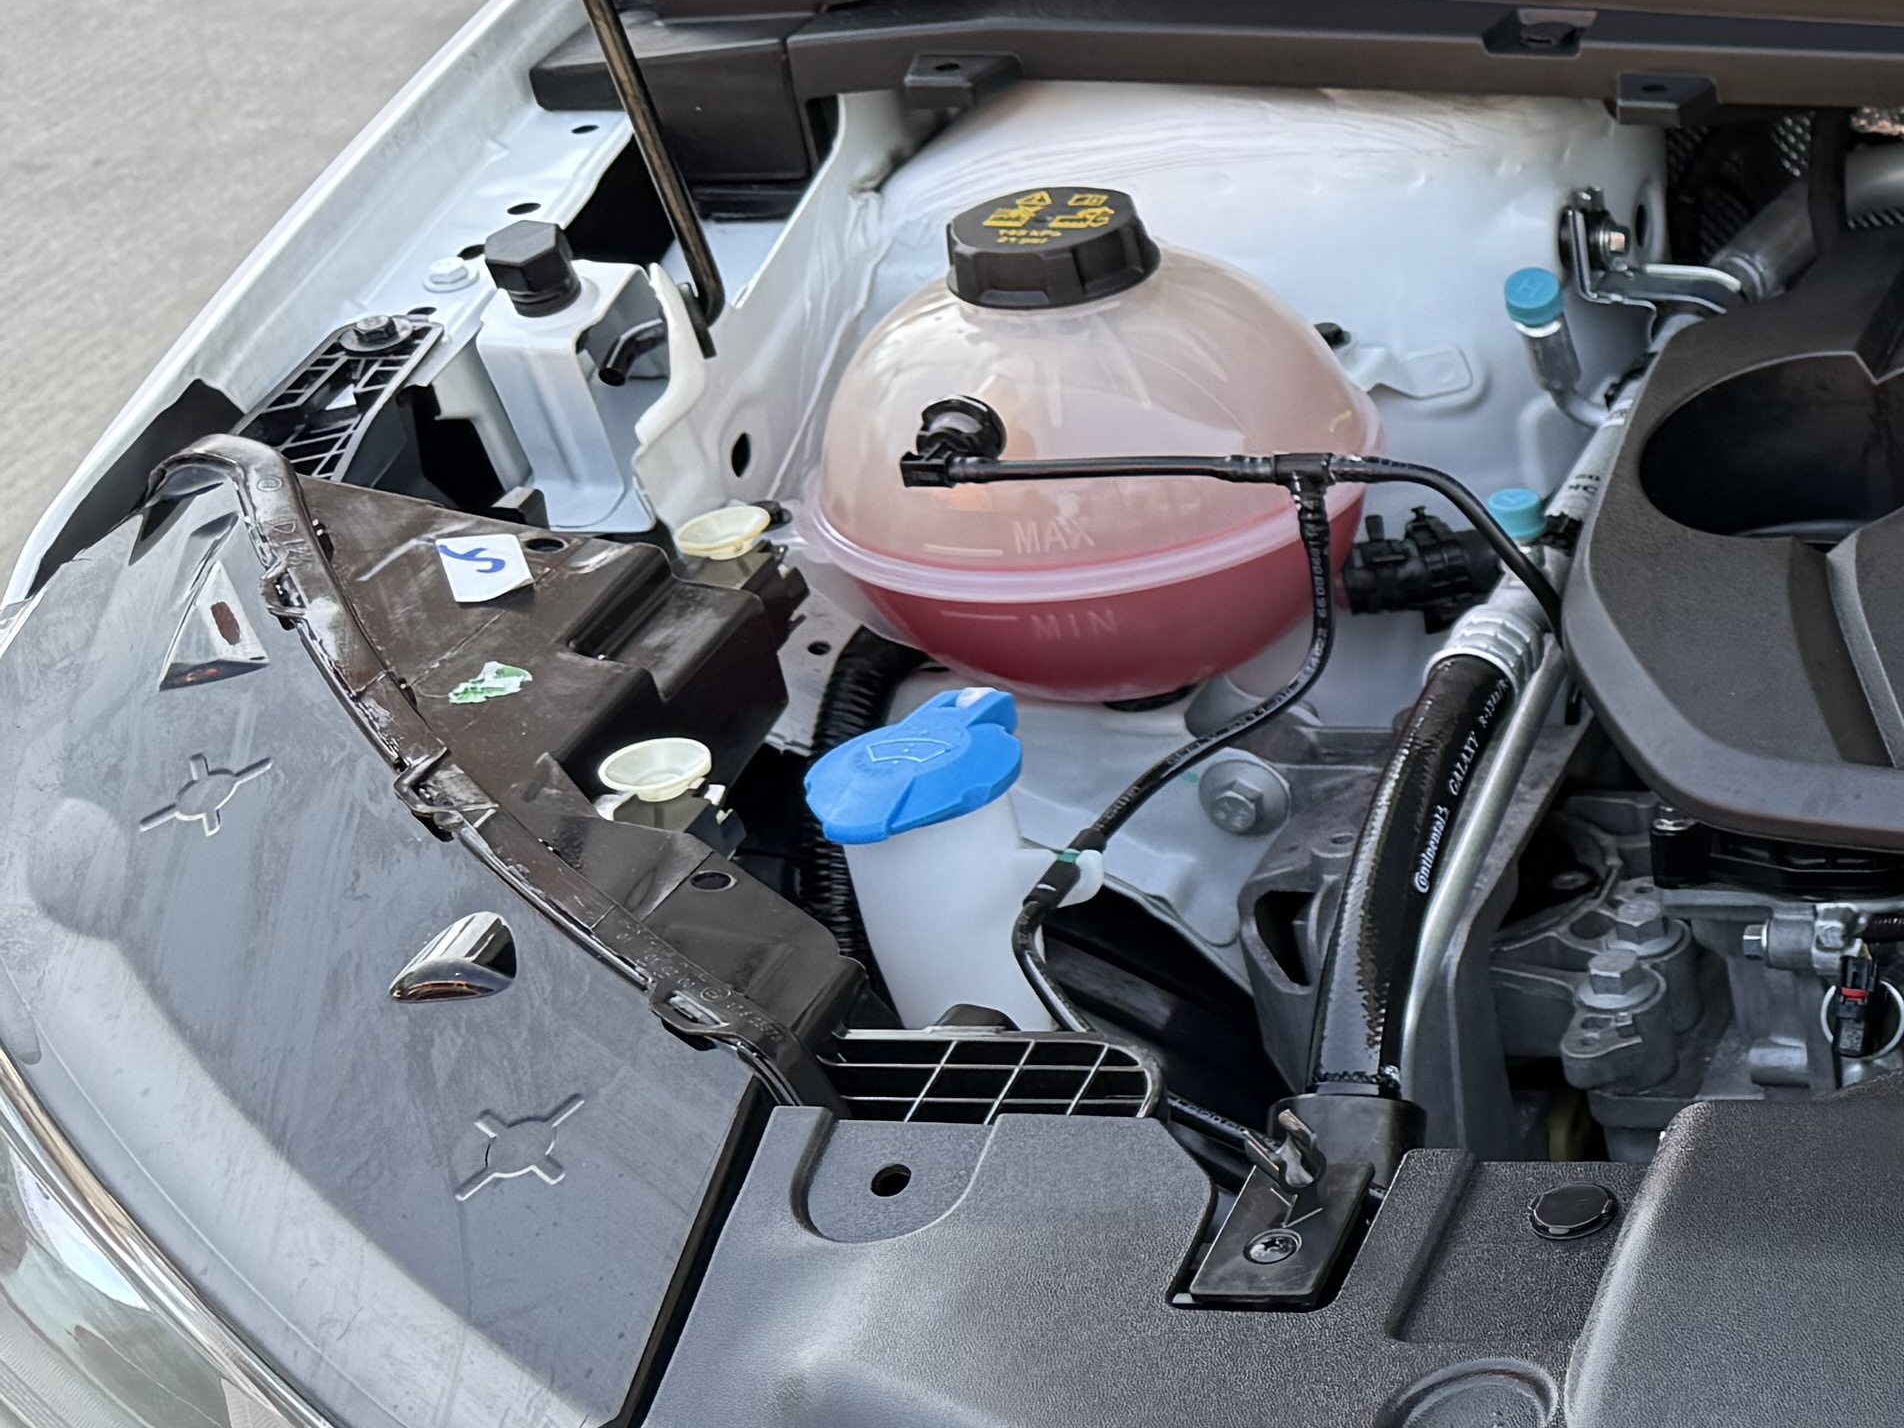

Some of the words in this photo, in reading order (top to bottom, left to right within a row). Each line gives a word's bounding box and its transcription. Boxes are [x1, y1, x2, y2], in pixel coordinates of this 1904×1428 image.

[1013, 517, 1095, 555] MAX
[1031, 609, 1118, 641] MIN
[1449, 731, 1479, 796] GALAXY
